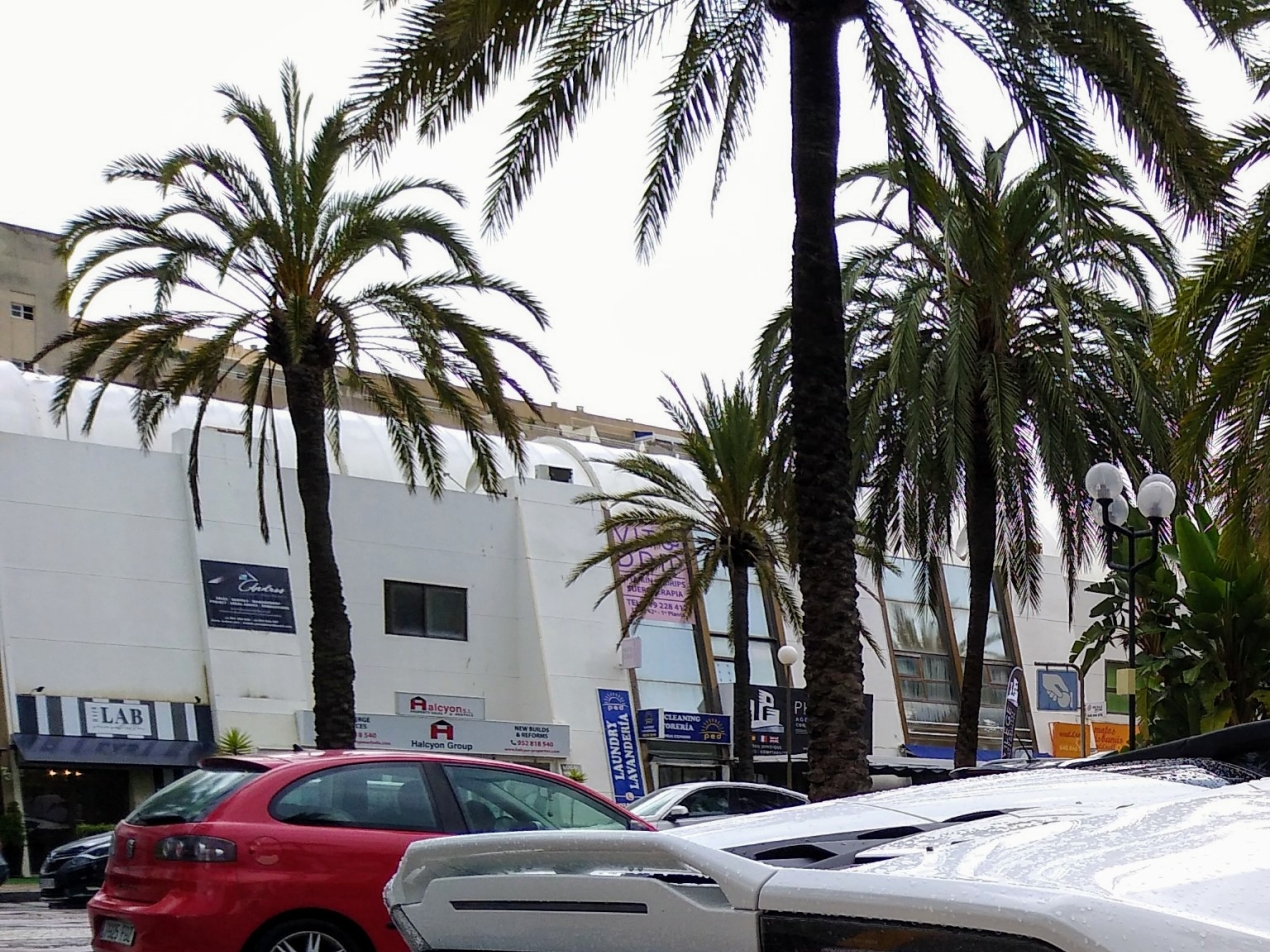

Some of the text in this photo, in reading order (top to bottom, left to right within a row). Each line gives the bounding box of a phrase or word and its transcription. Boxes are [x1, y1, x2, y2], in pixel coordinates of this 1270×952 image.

[659, 602, 673, 610] 228
[100, 706, 143, 725] LAB
[664, 714, 701, 723] CLEANING
[411, 740, 473, 751] Halcyon Group
[606, 720, 625, 781] LAUNDRY
[617, 713, 640, 789] LAVANDERÍA
